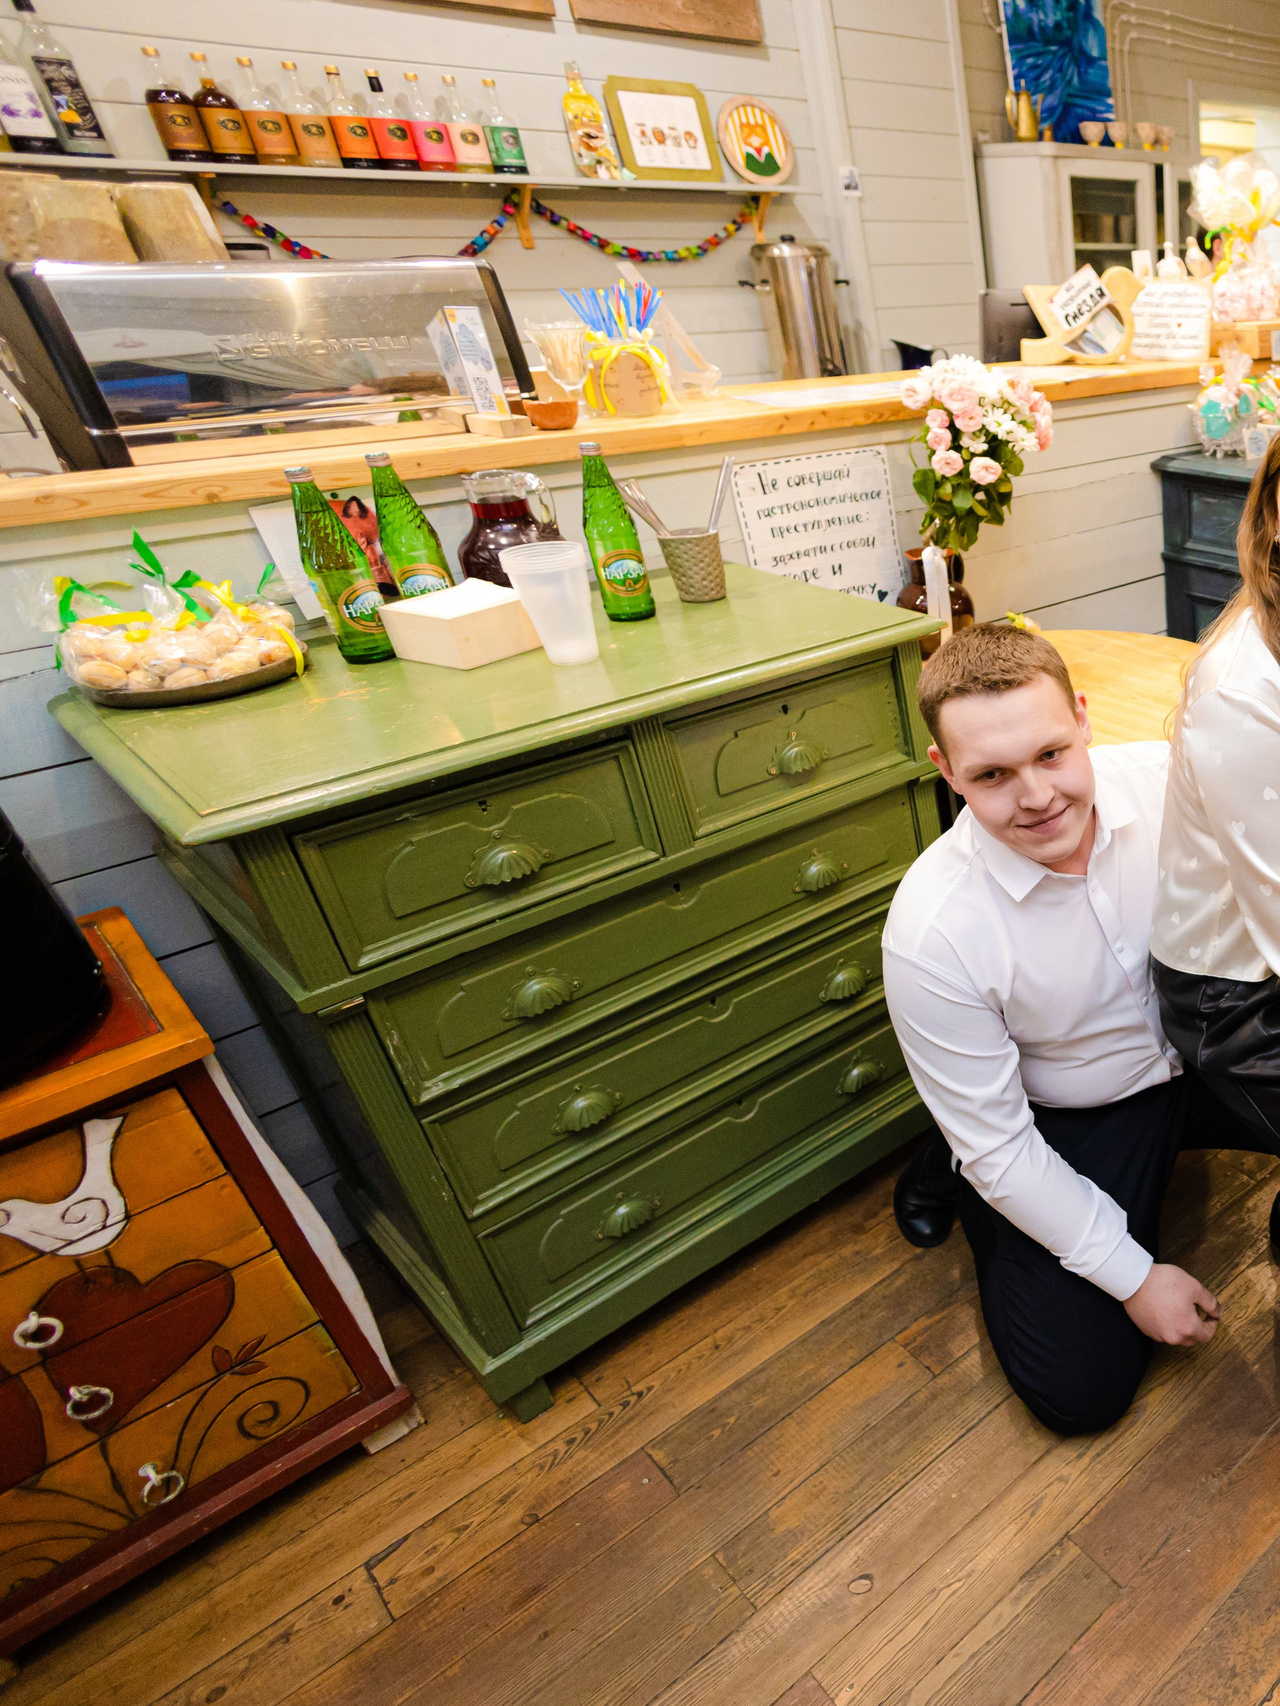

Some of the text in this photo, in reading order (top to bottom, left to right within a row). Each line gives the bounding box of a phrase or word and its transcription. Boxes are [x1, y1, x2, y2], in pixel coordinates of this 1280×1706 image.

[248, 335, 411, 360] SIMONELLI
[757, 463, 851, 495] Не совершай
[757, 489, 883, 520] гастрономическое
